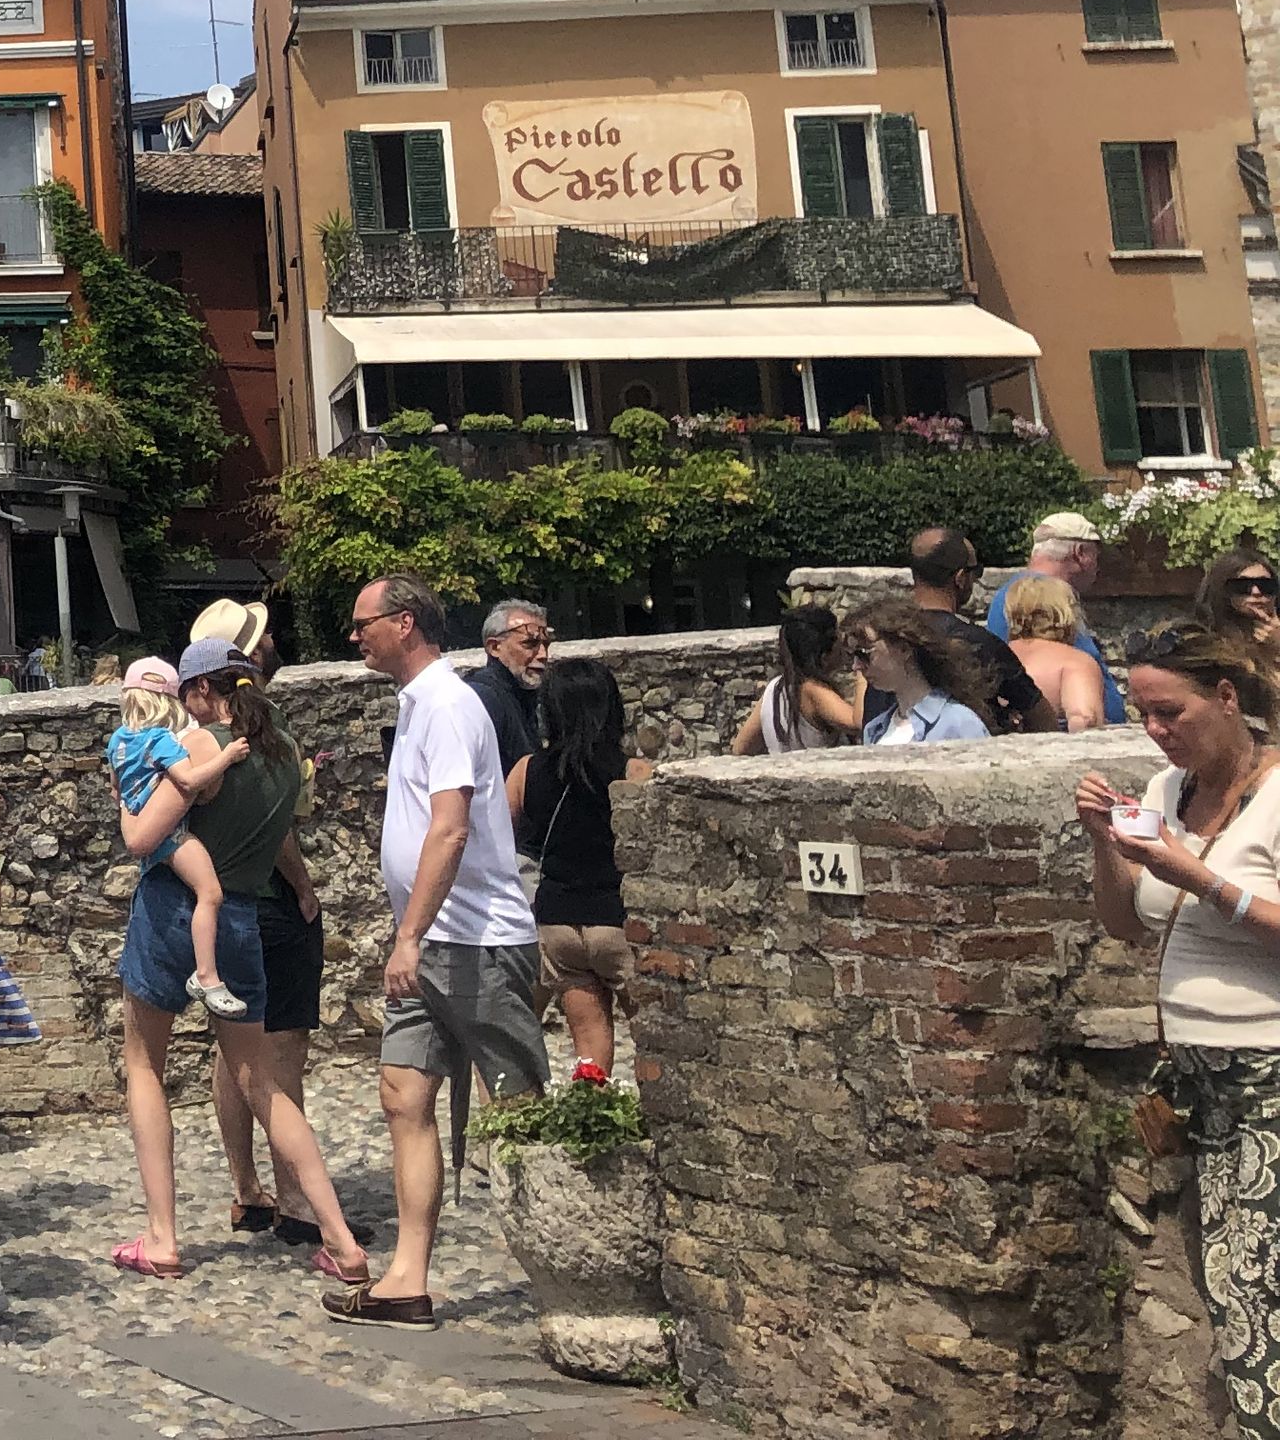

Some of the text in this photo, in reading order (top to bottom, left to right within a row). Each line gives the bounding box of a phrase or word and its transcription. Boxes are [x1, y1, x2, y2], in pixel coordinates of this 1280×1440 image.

[504, 117, 621, 153] Piccolo
[512, 149, 743, 203] Castello
[808, 852, 848, 890] 34
